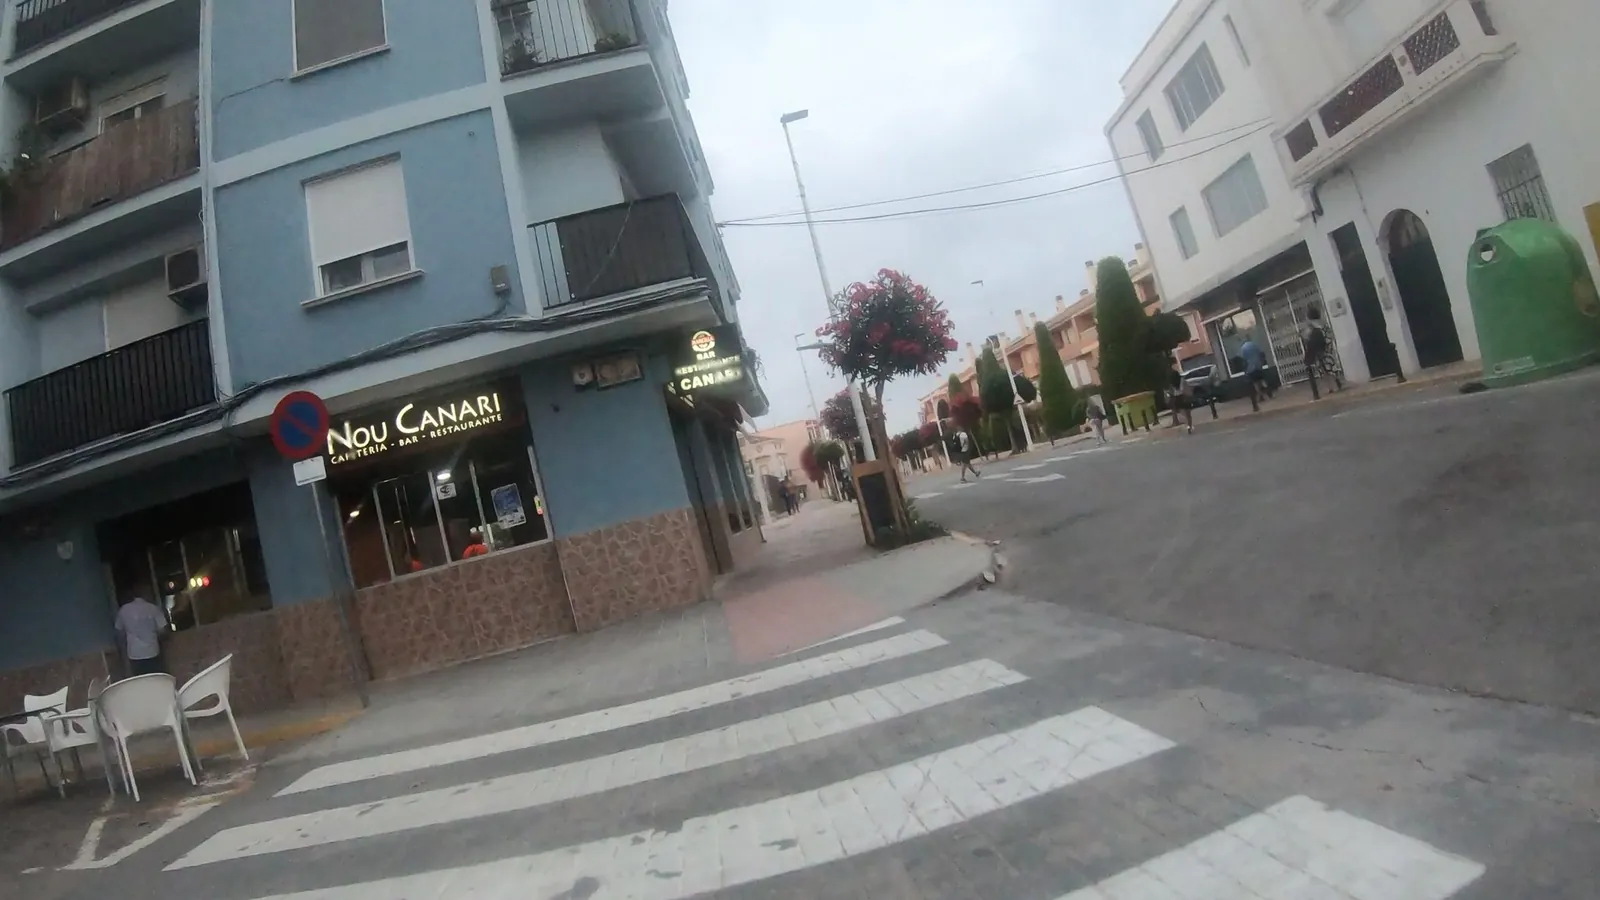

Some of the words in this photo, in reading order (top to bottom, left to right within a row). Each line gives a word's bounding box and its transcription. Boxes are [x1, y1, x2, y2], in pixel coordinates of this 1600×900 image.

[396, 393, 501, 434] CANARI
[399, 435, 419, 447] BAR
[430, 413, 503, 439] RESTAURANTE
